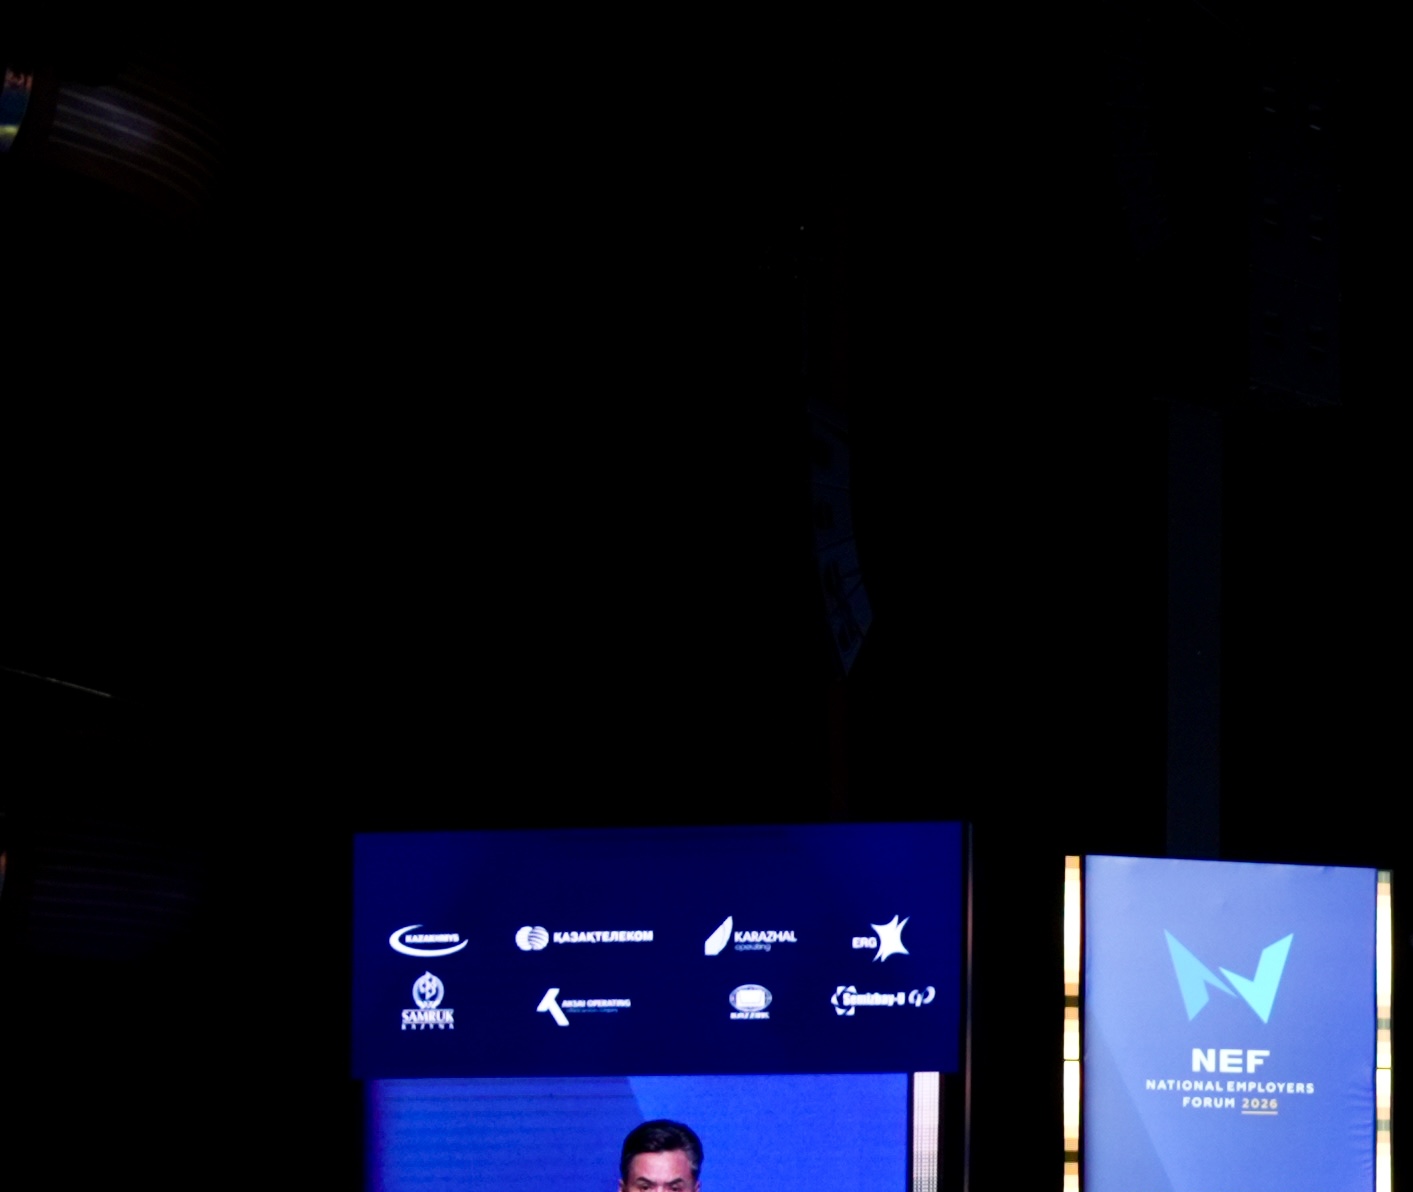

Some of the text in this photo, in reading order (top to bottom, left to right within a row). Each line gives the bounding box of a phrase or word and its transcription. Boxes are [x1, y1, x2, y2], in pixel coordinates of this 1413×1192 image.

[553, 930, 654, 944] ҚАЗАҚТЕЛЕКОМ
[734, 930, 798, 943] KARAZHAL
[852, 936, 877, 949] ERG
[402, 1010, 455, 1023] SAMRUK
[1191, 1048, 1271, 1074] NEF
[1145, 1079, 1315, 1094] NATIONAL EMPLOYERS
[1182, 1096, 1278, 1110] FORUM 2026
